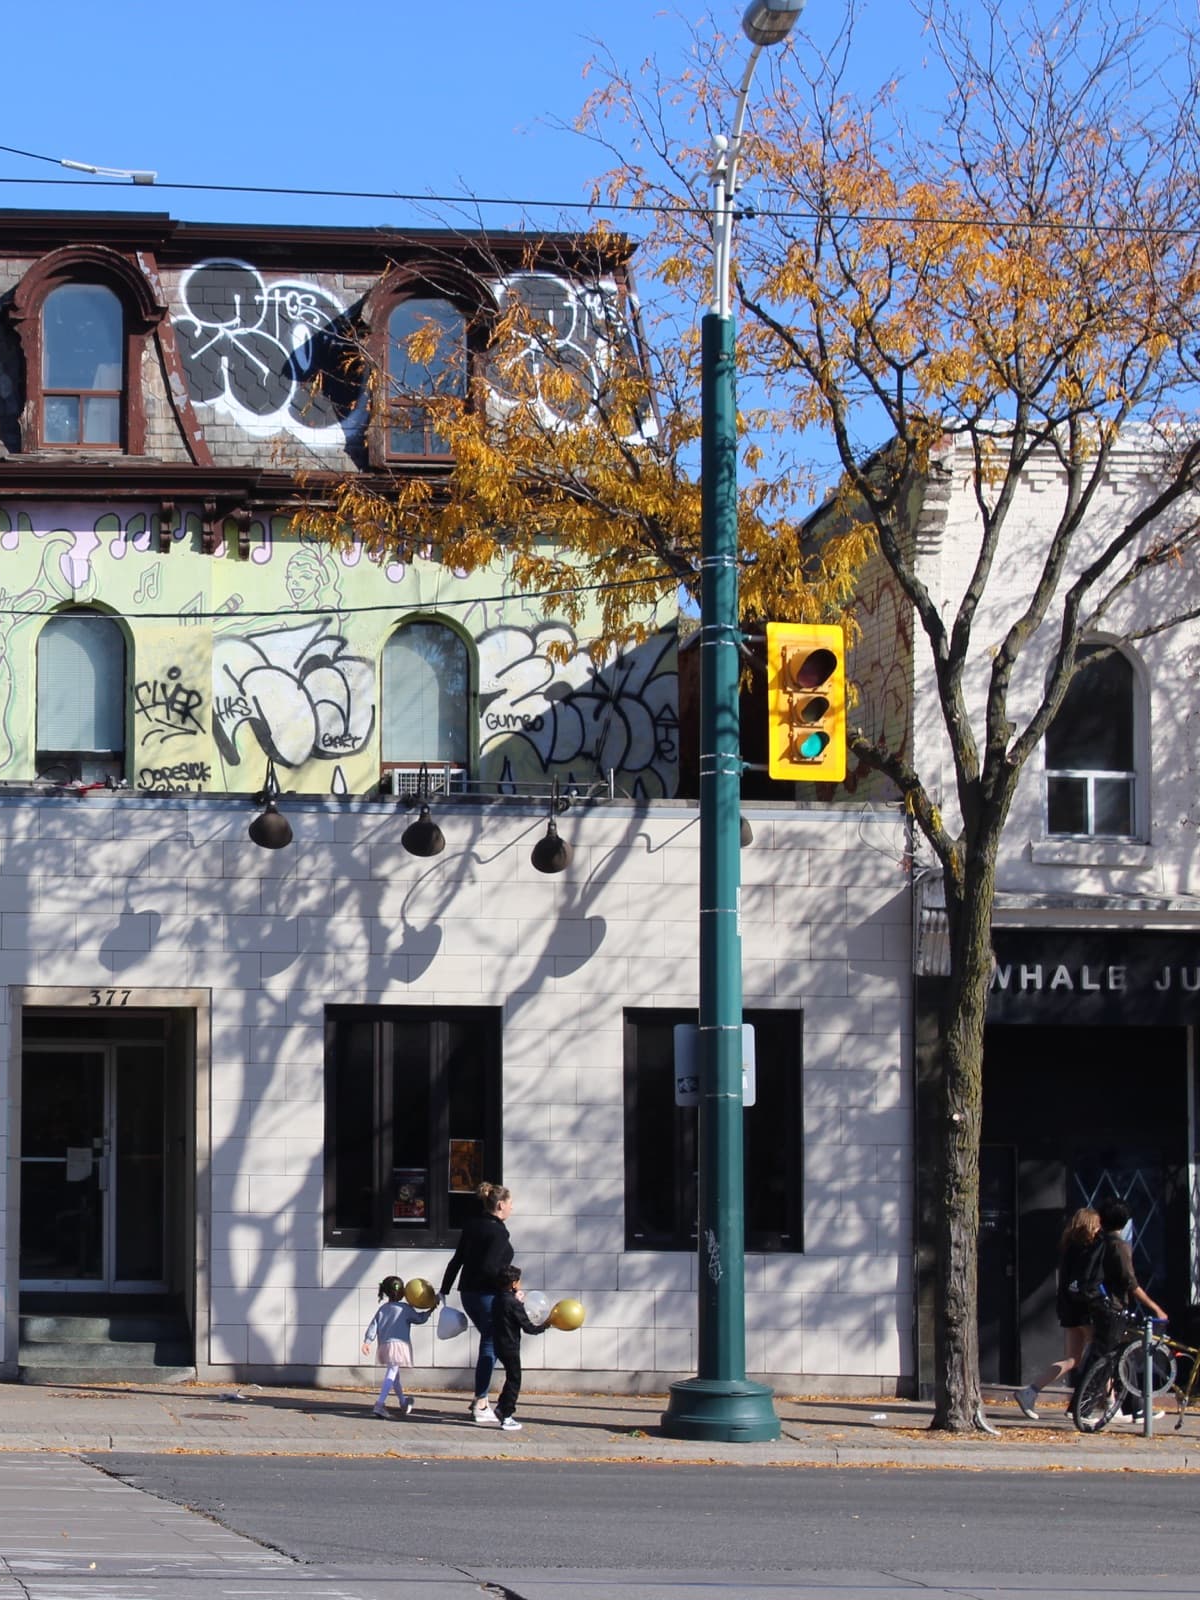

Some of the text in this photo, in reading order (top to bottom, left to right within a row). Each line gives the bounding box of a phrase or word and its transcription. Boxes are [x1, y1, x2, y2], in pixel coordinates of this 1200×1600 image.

[486, 713, 545, 732] GUMBO
[989, 964, 1200, 991] WHALE JU
[89, 990, 132, 1006] 377
